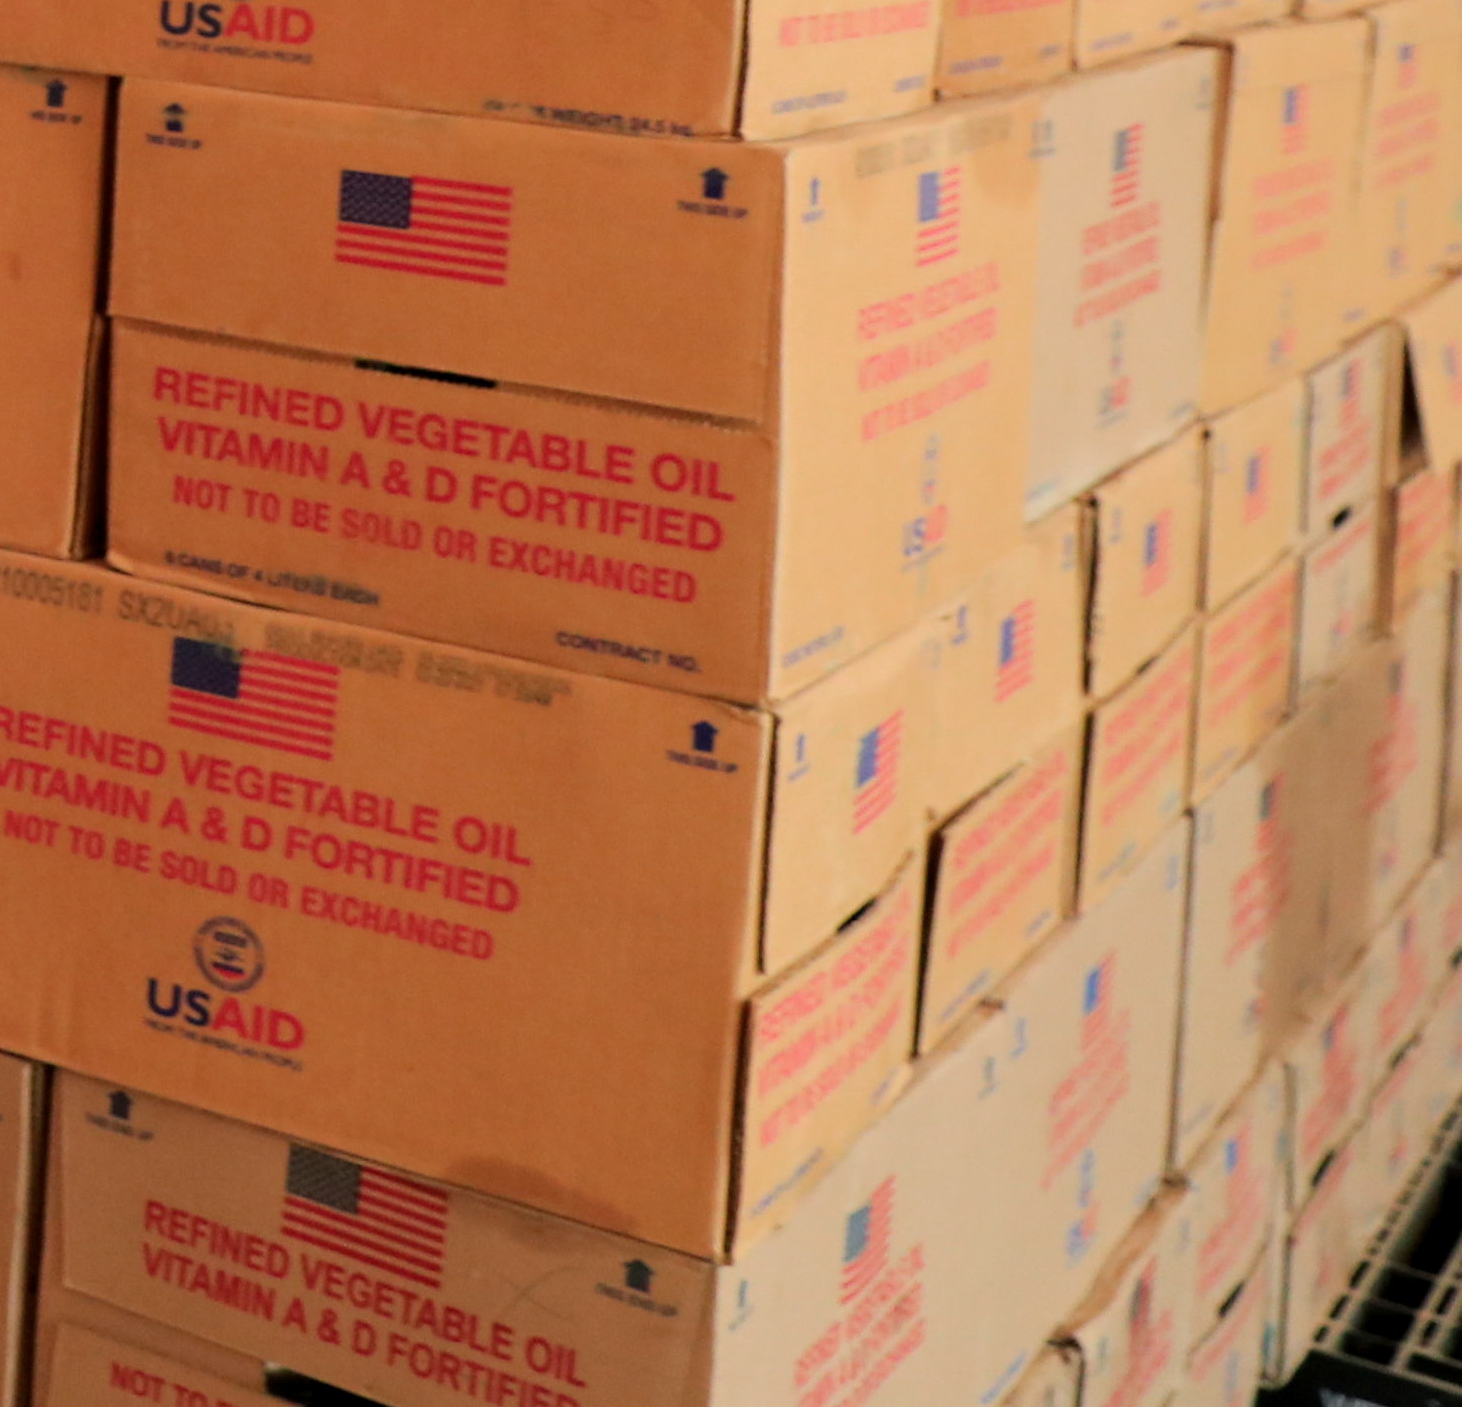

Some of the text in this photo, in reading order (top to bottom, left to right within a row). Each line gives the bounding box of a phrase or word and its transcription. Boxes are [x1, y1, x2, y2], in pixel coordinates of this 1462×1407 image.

[161, 0, 314, 44] USAID
[161, 794, 189, 833] A
[200, 803, 228, 844] &
[241, 814, 273, 854] D
[285, 824, 519, 915] FORTIFIED
[180, 749, 439, 843] VEGETABLE
[453, 813, 531, 866] OIL
[4, 809, 493, 962] NOT TO BE SOLD OR EXCHANGED
[148, 980, 304, 1052] USAID
